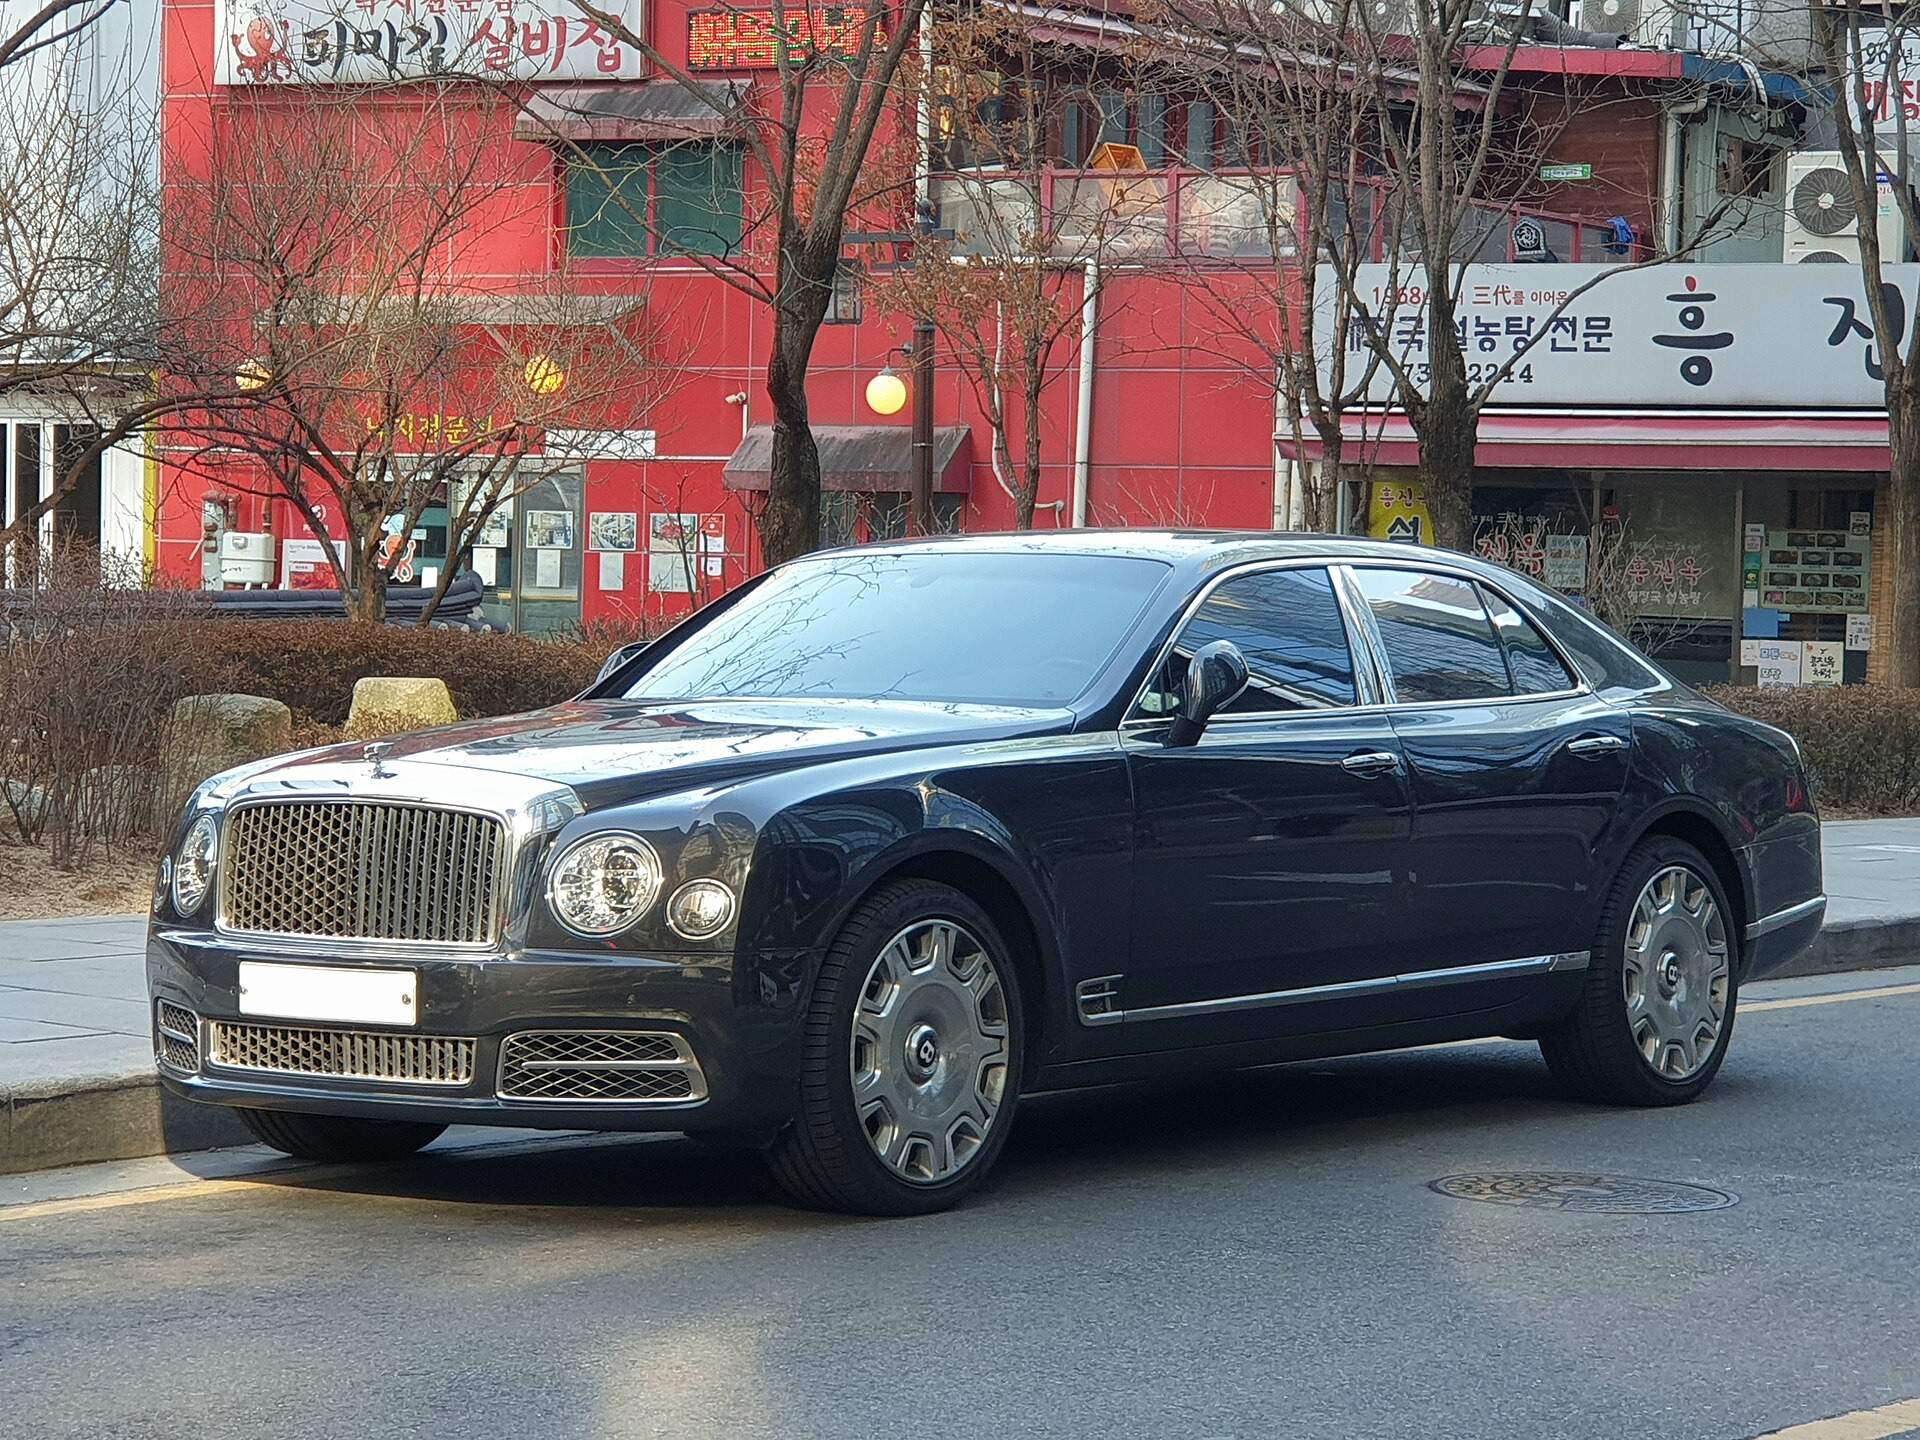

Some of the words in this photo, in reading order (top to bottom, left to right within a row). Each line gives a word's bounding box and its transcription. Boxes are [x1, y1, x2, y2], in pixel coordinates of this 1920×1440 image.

[470, 15, 622, 73] 실비집
[1472, 284, 1525, 306] 三代를
[1530, 290, 1568, 306] 이어온
[1551, 316, 1613, 353] 전문
[1379, 486, 1426, 508] 흥진
[1627, 556, 1702, 586] 흥진옥
